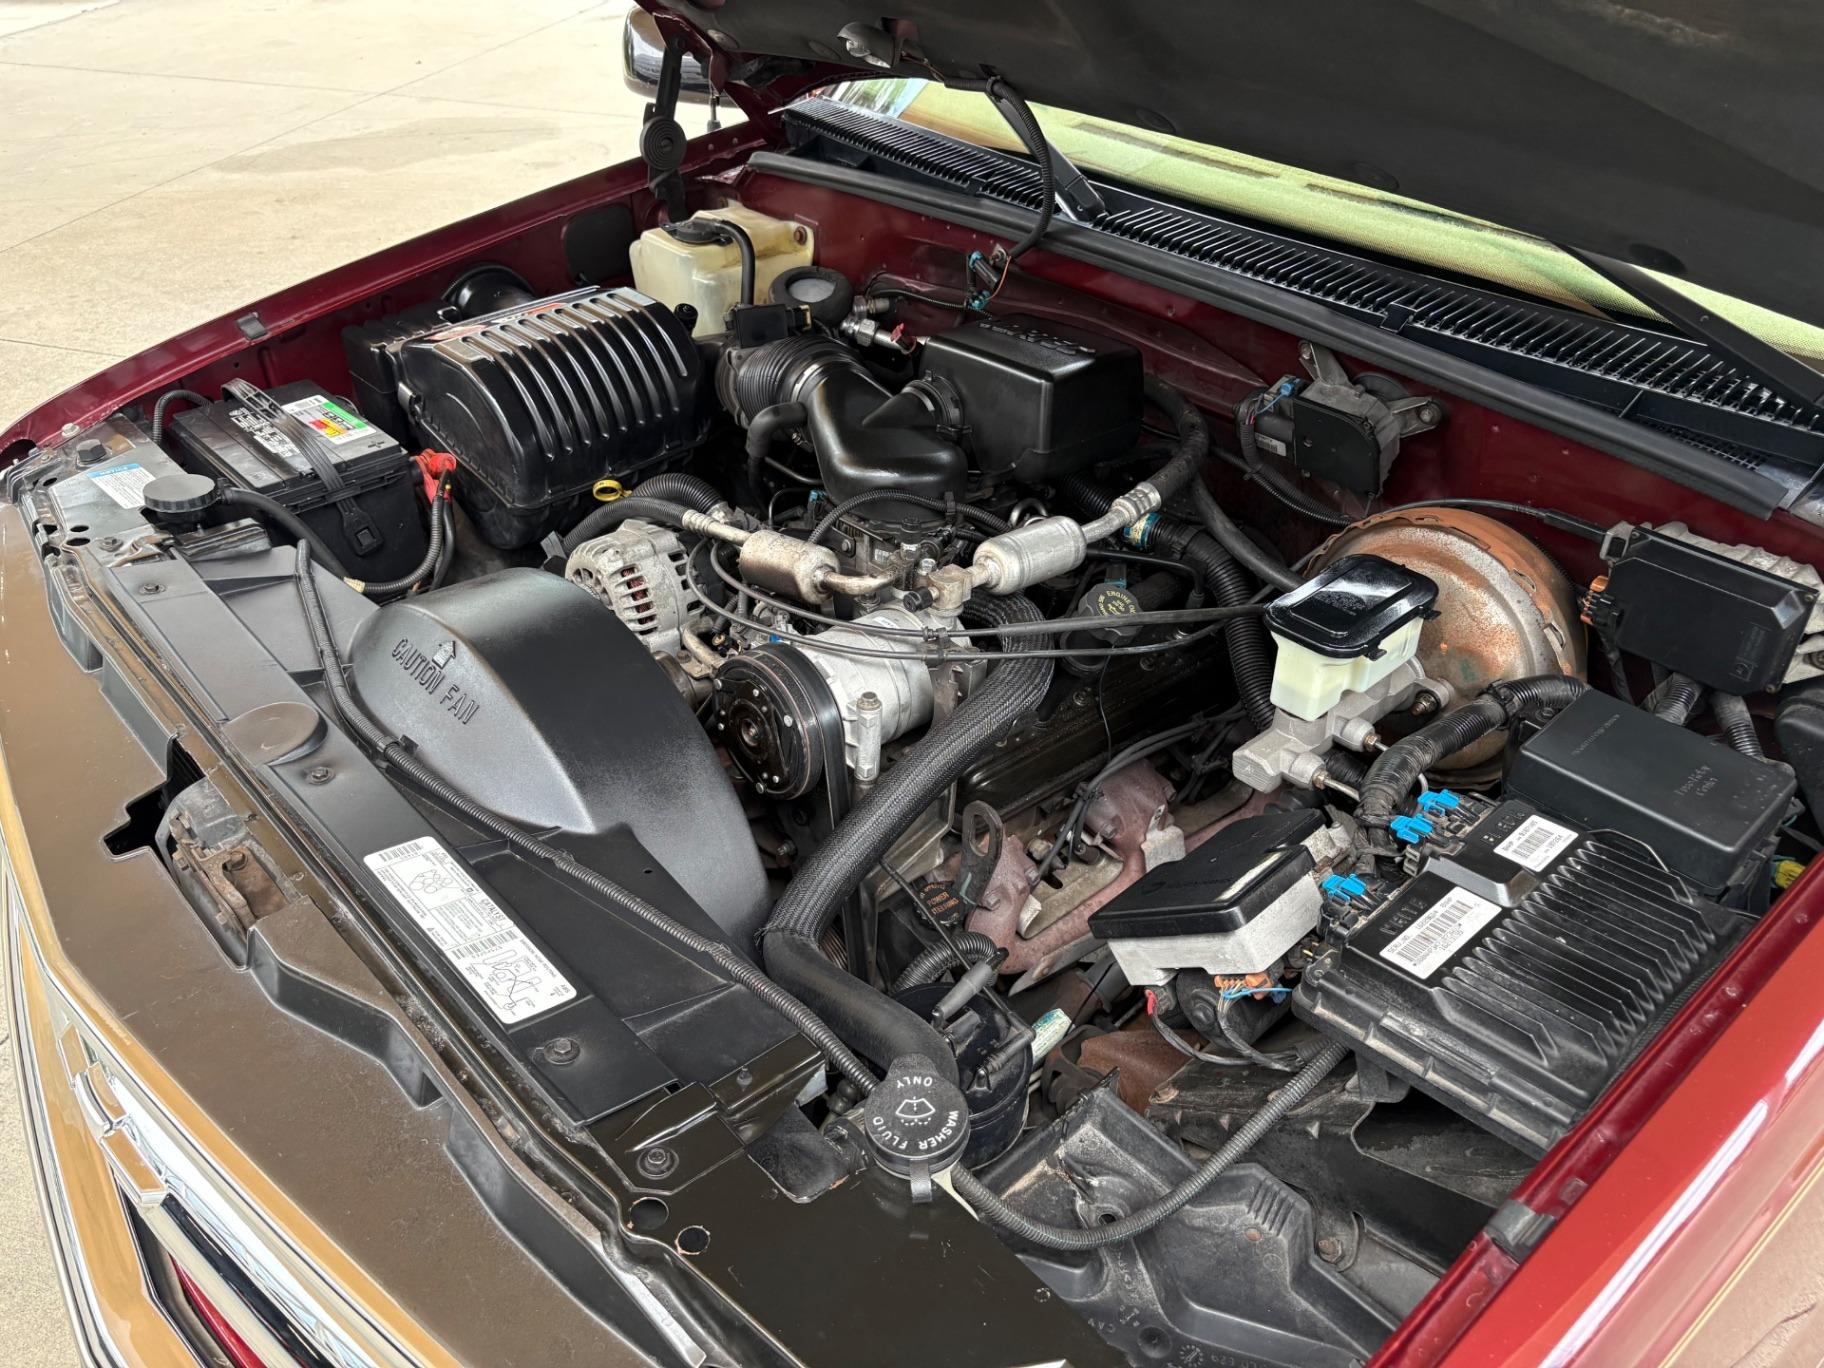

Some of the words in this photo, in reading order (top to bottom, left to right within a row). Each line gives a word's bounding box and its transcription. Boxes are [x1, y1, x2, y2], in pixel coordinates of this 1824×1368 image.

[1105, 590, 1132, 604] ENGINE
[391, 637, 445, 695] CAUTION
[438, 683, 479, 725] FAN
[480, 898, 507, 923] CATALYST
[896, 1075, 933, 1089] ONLY
[872, 1115, 909, 1150] FLUID
[918, 1109, 960, 1150] WASHER
